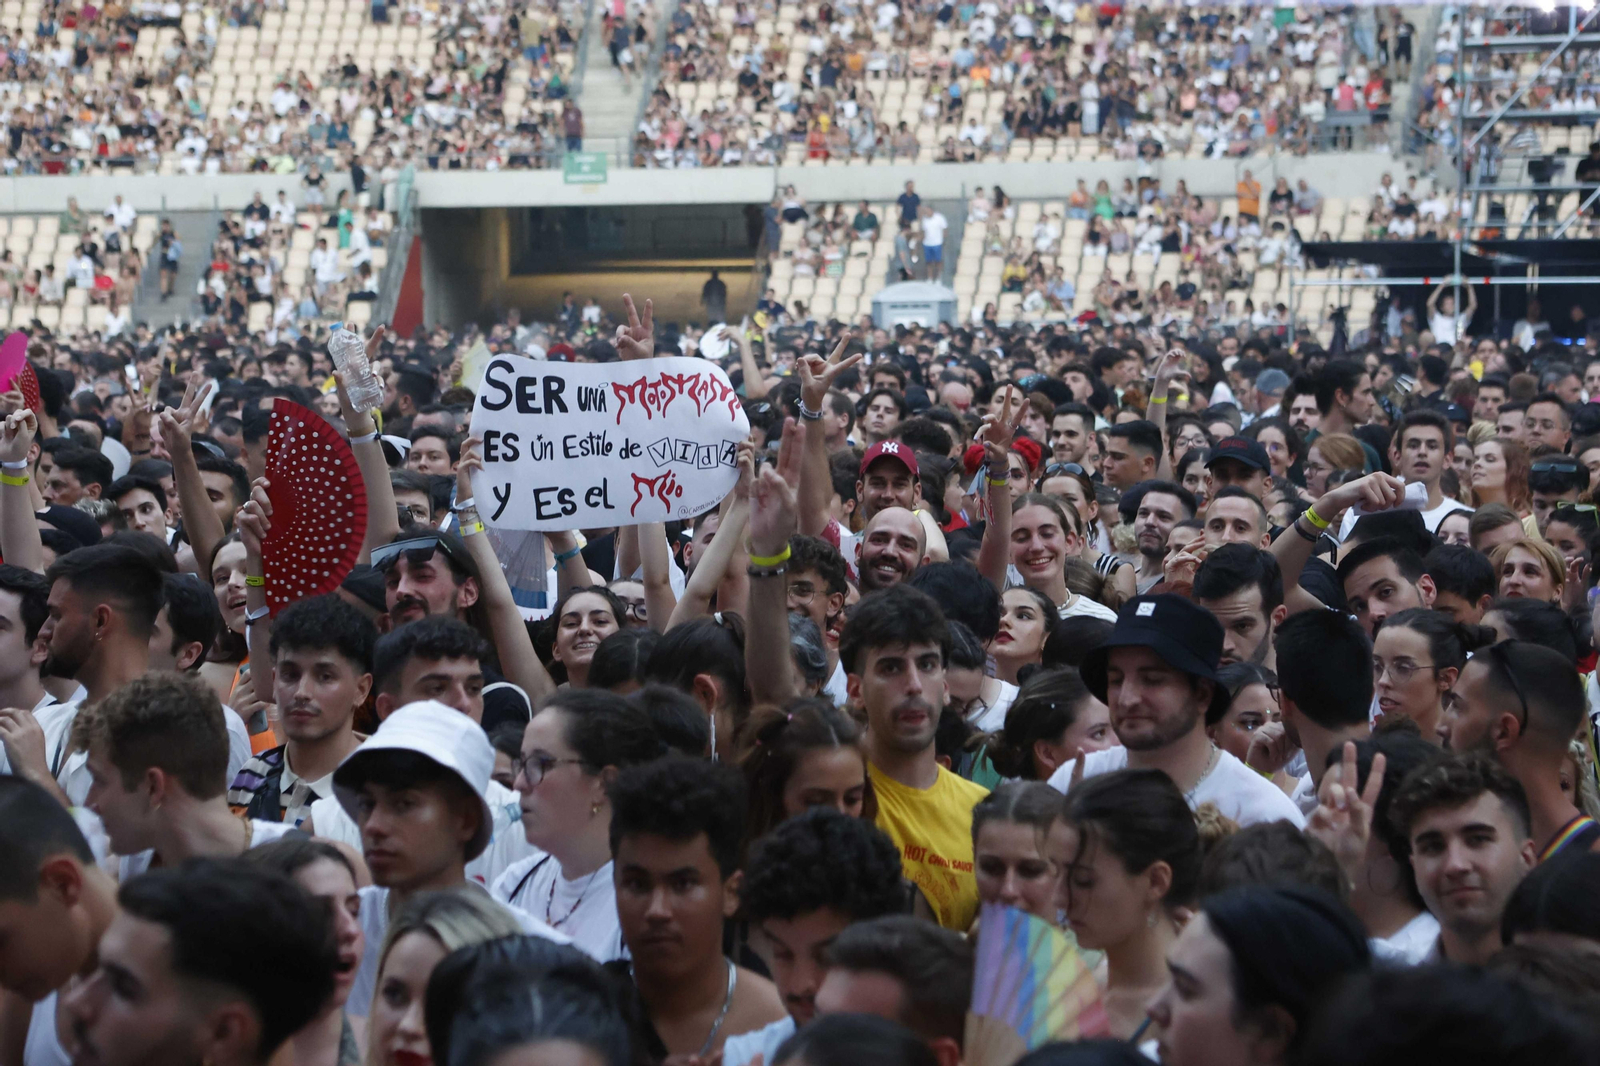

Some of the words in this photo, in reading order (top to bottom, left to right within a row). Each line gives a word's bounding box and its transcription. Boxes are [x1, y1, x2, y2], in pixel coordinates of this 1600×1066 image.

[481, 359, 569, 415] SER
[577, 385, 608, 412] UNA
[484, 430, 520, 462] ES
[563, 430, 613, 459] Estilo
[619, 438, 643, 459] de
[585, 478, 615, 509] el
[904, 844, 926, 863] HOT
[952, 860, 973, 873] SAUCE
